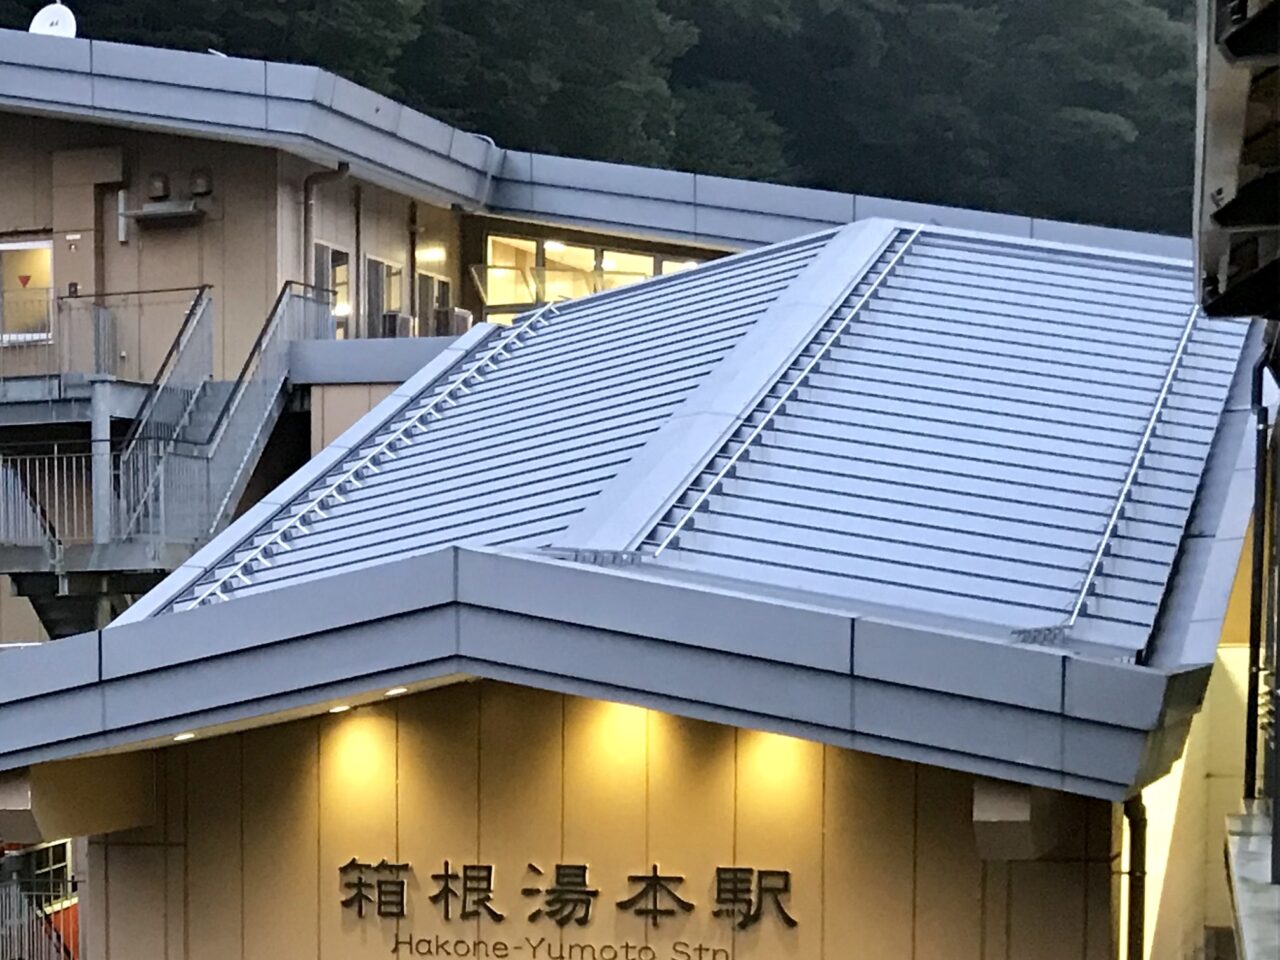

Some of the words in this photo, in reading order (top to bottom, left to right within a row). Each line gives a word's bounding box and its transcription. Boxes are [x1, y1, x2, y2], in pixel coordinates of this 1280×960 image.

[338, 857, 798, 929] 箱根湯本駅
